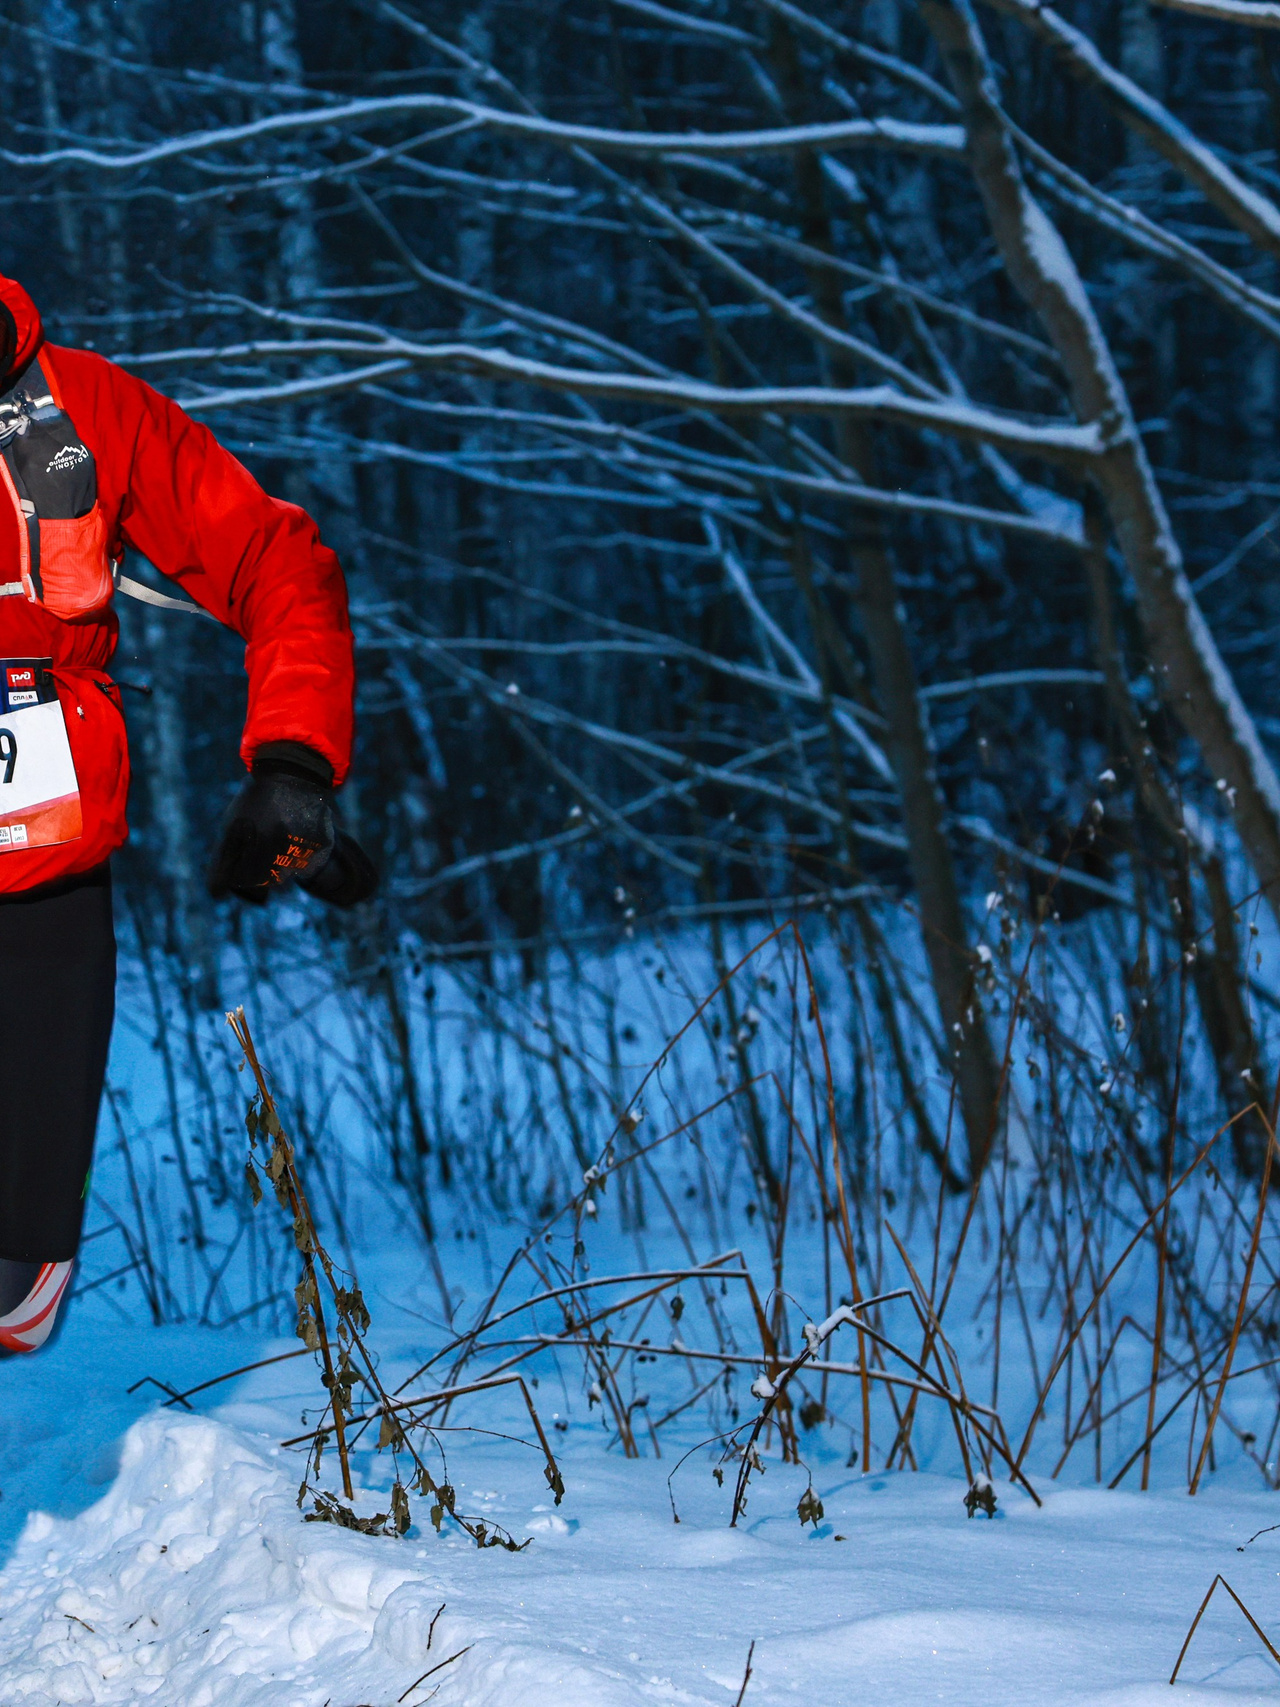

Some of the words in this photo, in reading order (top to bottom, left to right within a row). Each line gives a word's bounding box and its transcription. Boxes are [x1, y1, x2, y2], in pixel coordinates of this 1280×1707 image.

[49, 454, 76, 467] outdoor
[55, 457, 83, 471] INOXTO
[273, 854, 293, 867] FOX
